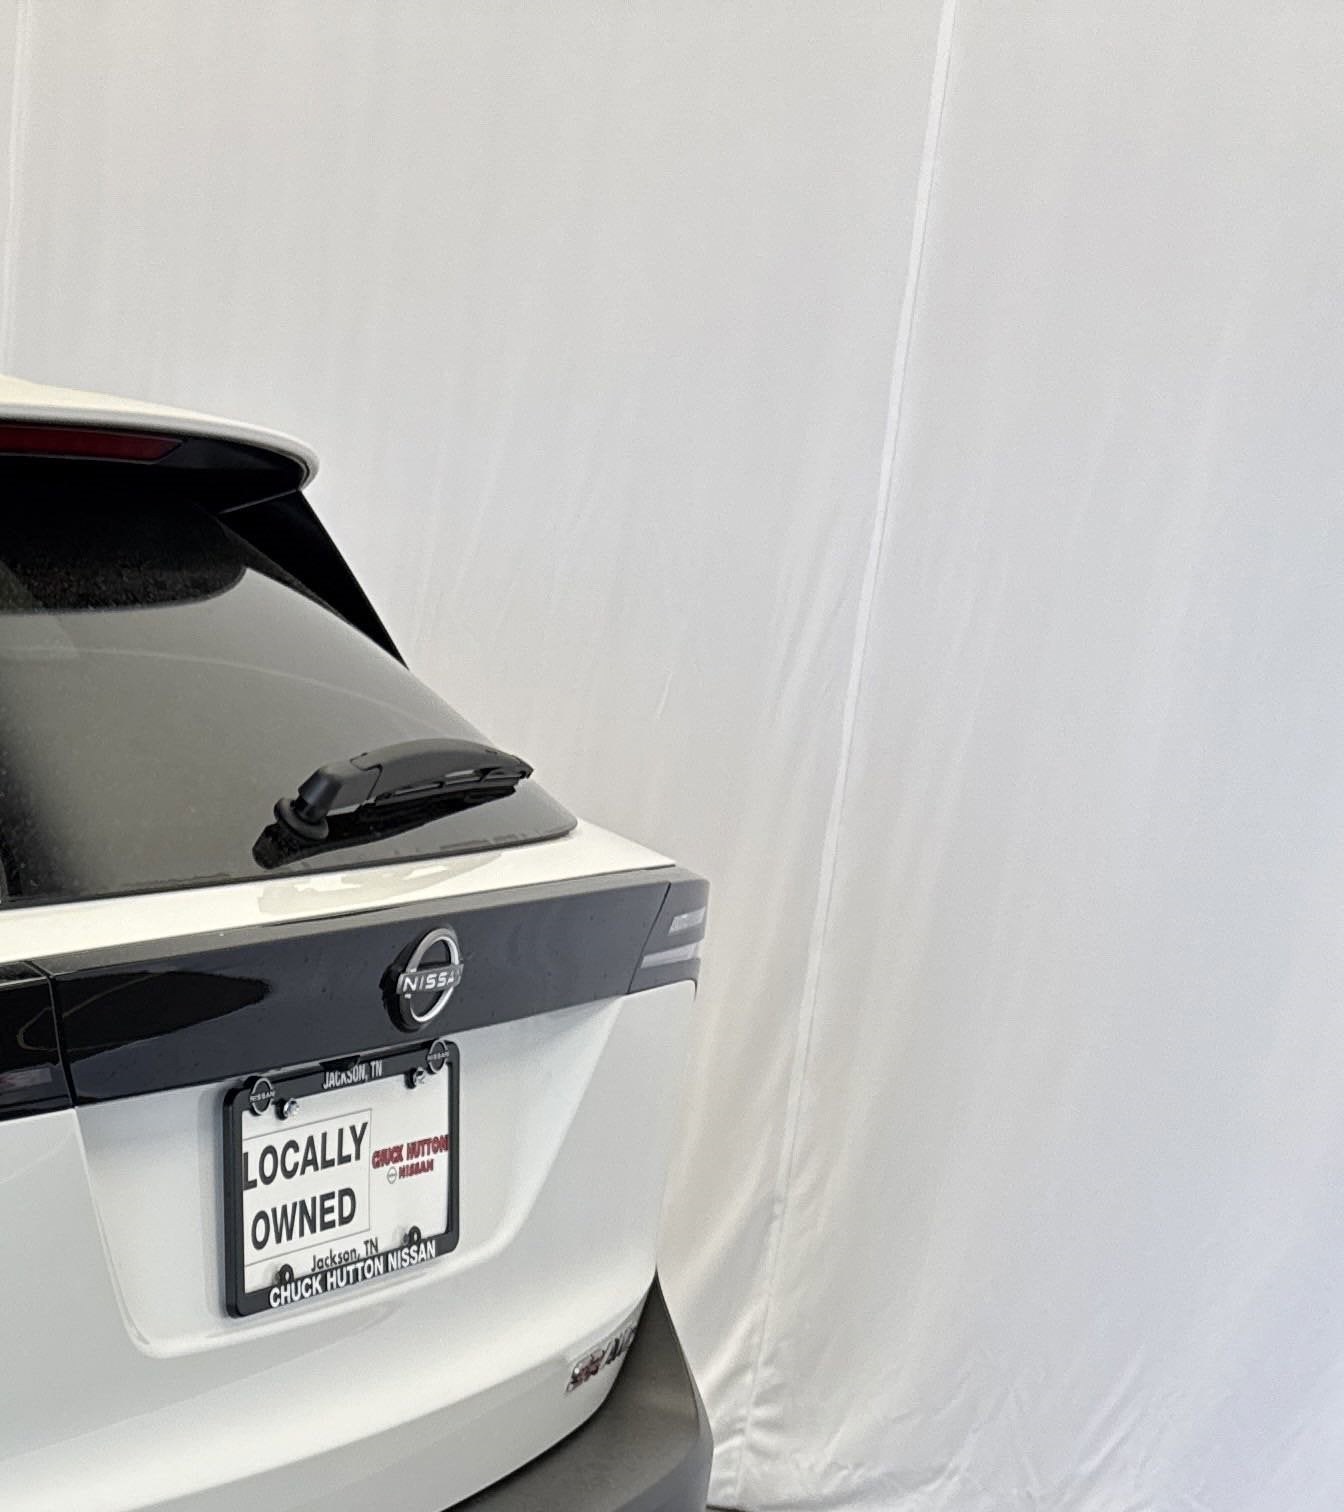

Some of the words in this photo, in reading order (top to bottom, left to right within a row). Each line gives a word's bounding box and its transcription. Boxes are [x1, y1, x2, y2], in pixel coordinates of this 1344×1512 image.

[370, 1060, 382, 1077] TN
[242, 1121, 368, 1191] LOCALLY
[372, 1144, 404, 1169] CHUCK
[406, 1134, 449, 1161] HUTTON
[251, 1187, 357, 1251] OWNED
[269, 1273, 323, 1308] CHUCK
[326, 1256, 384, 1291] HUTTON
[387, 1240, 436, 1270] NISSAN
[311, 1247, 361, 1272] Jackson,
[363, 1237, 379, 1256] TN
